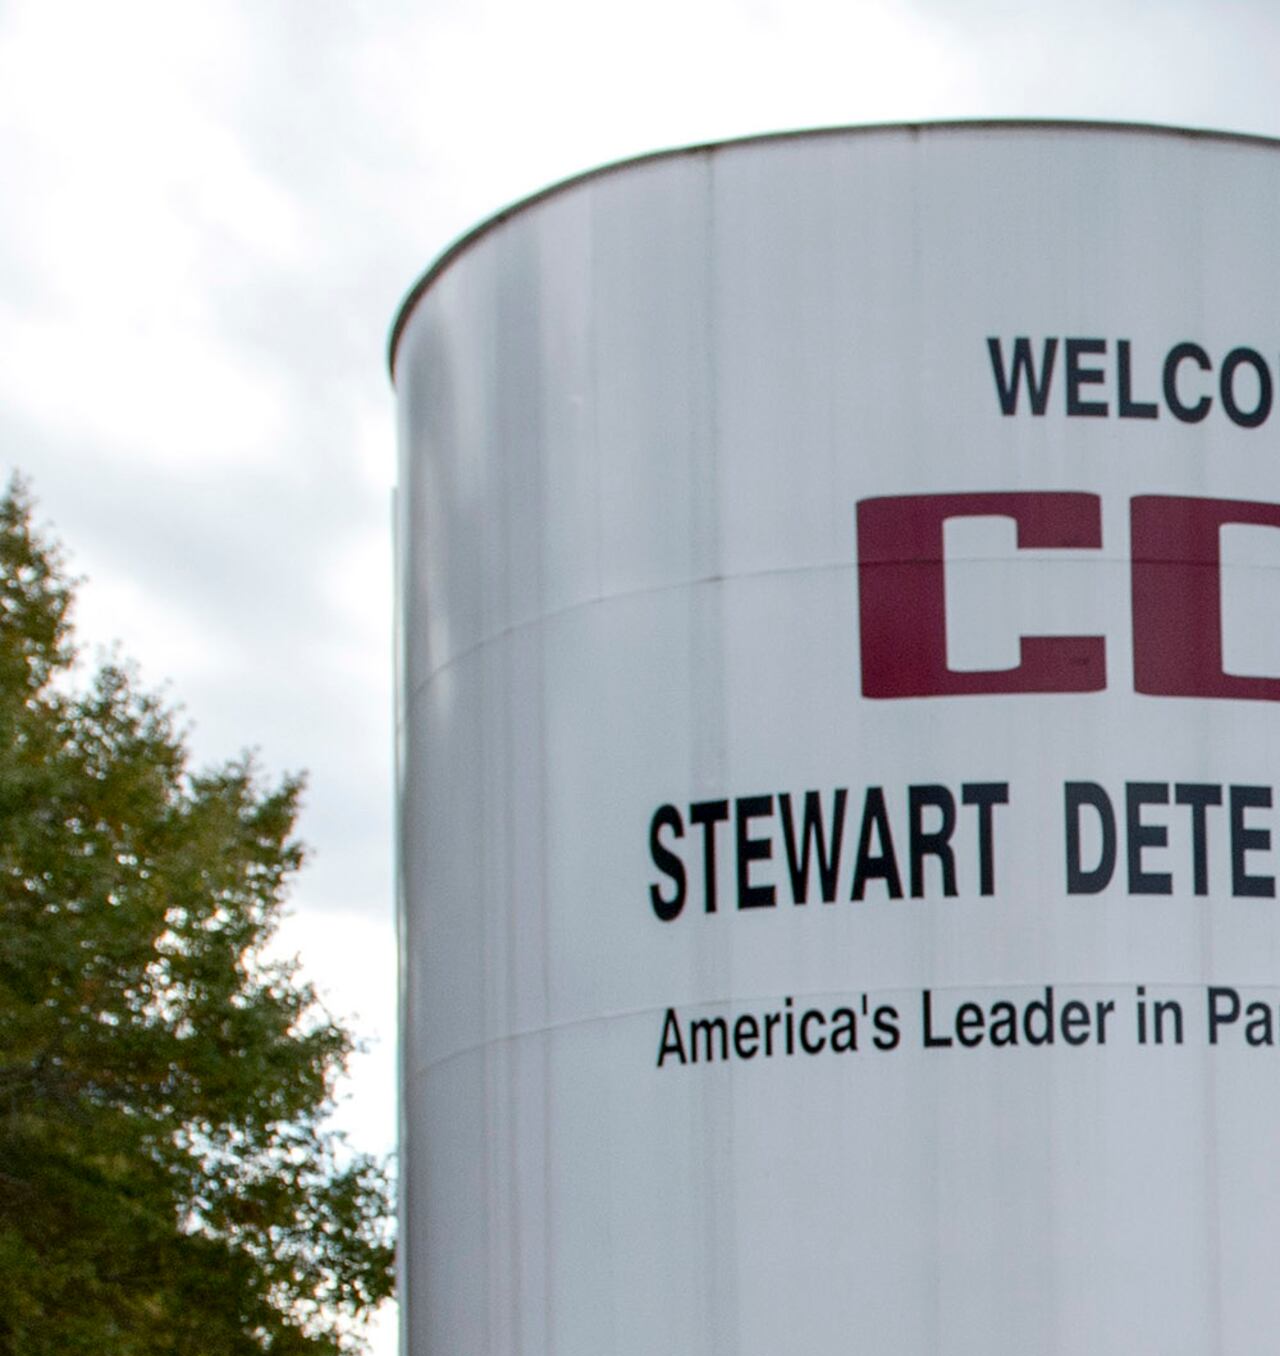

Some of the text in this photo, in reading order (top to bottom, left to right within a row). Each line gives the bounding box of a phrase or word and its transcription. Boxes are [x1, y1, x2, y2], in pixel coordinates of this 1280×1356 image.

[649, 782, 1010, 923] STEWART
[656, 993, 901, 1068] America's
[922, 985, 1115, 1049] Leader
[1136, 985, 1184, 1046] in
